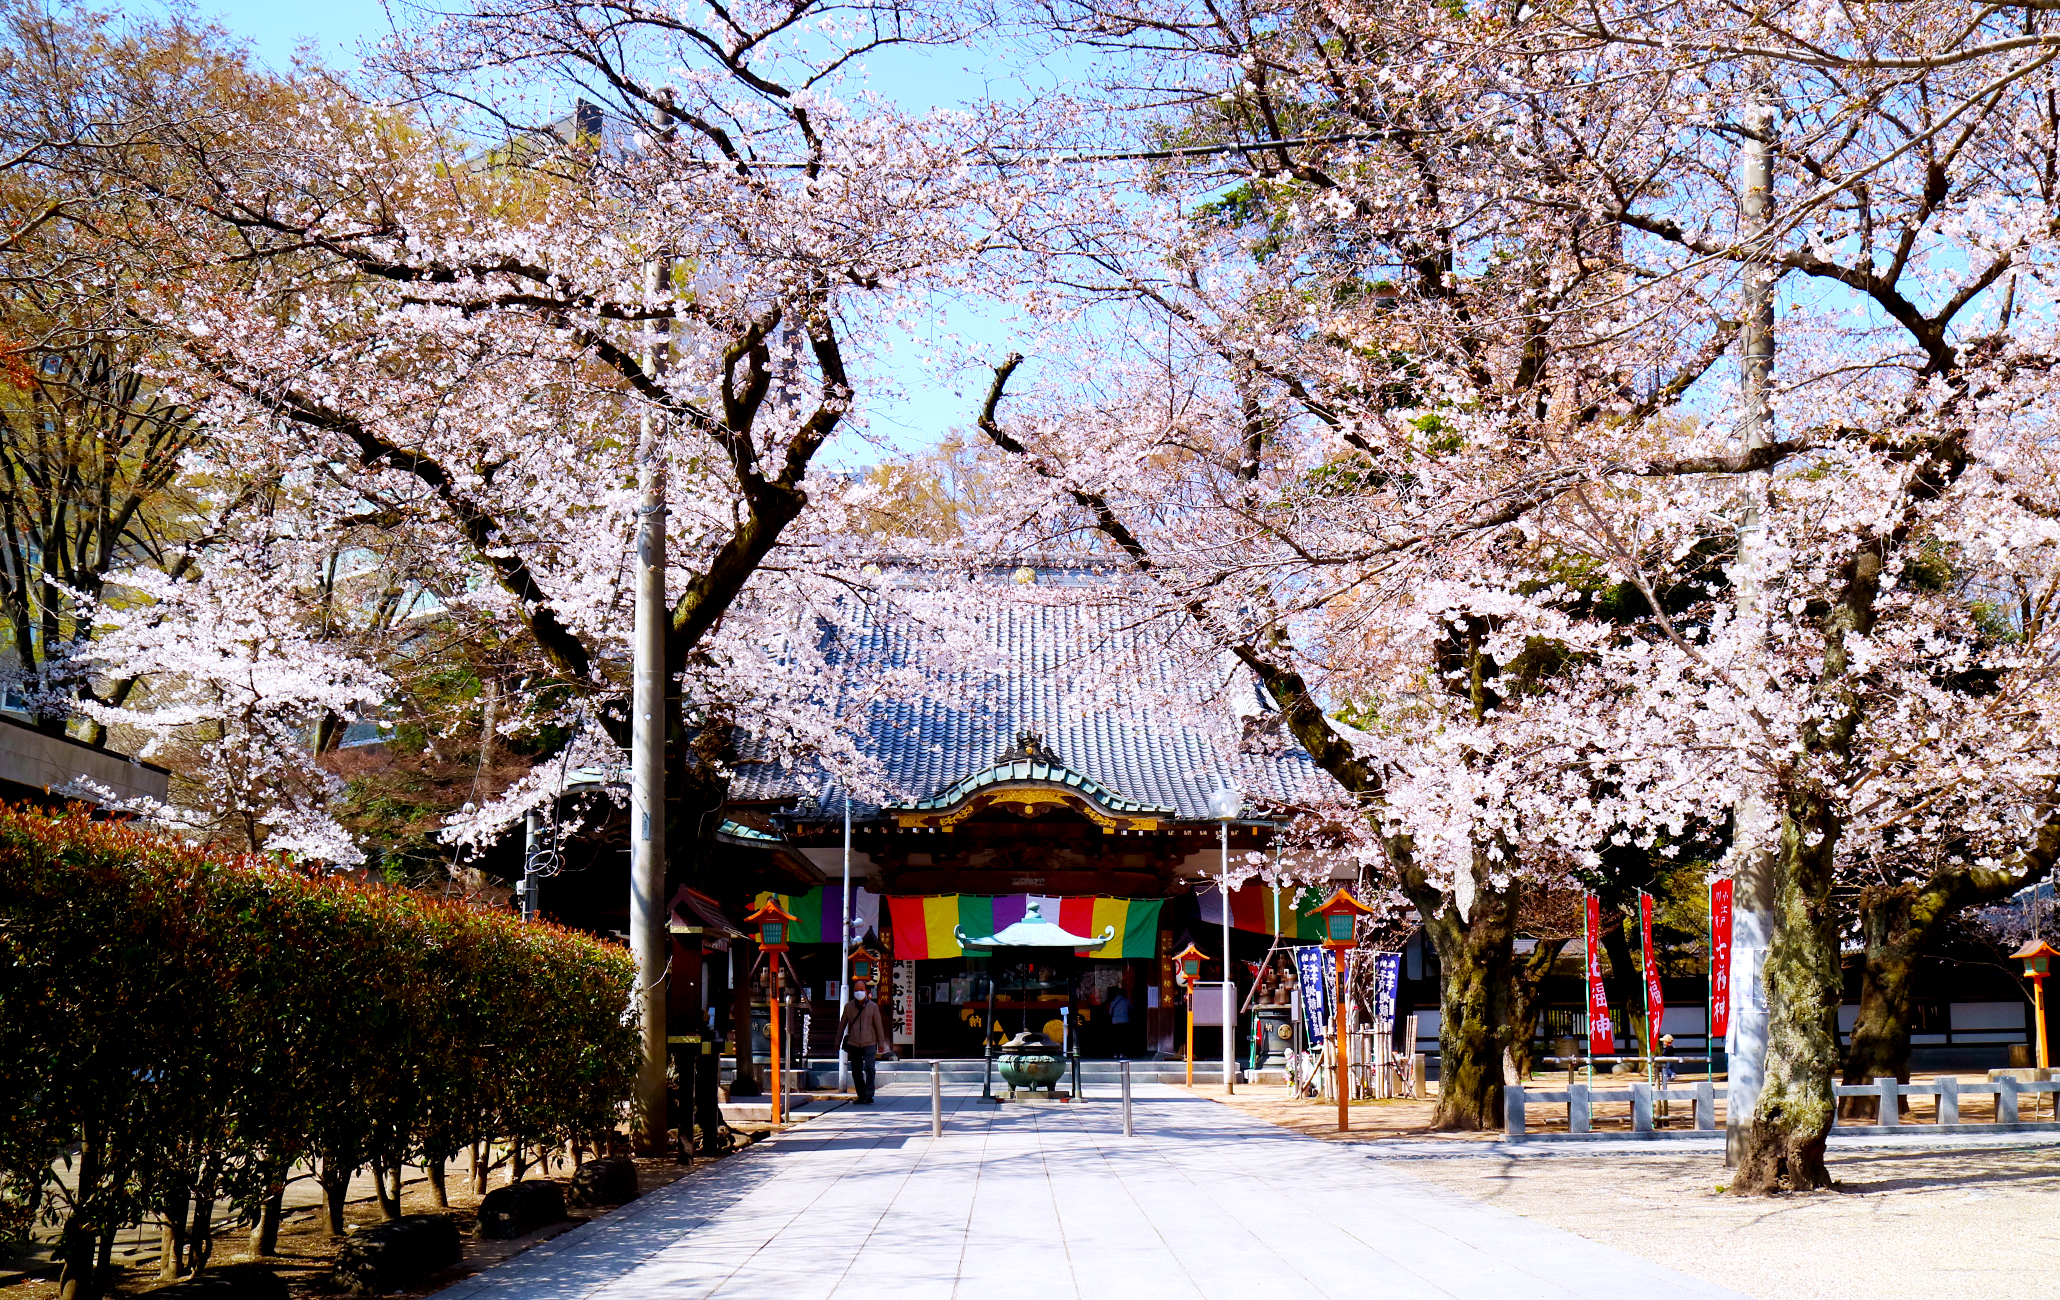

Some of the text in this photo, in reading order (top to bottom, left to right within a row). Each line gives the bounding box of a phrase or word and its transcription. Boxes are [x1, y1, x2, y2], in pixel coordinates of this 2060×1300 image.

[1720, 891, 1729, 928] 小江戸
[1590, 953, 1611, 1041] 七福神
[1714, 936, 1728, 1023] 七福神
[969, 1015, 982, 1028] 納
